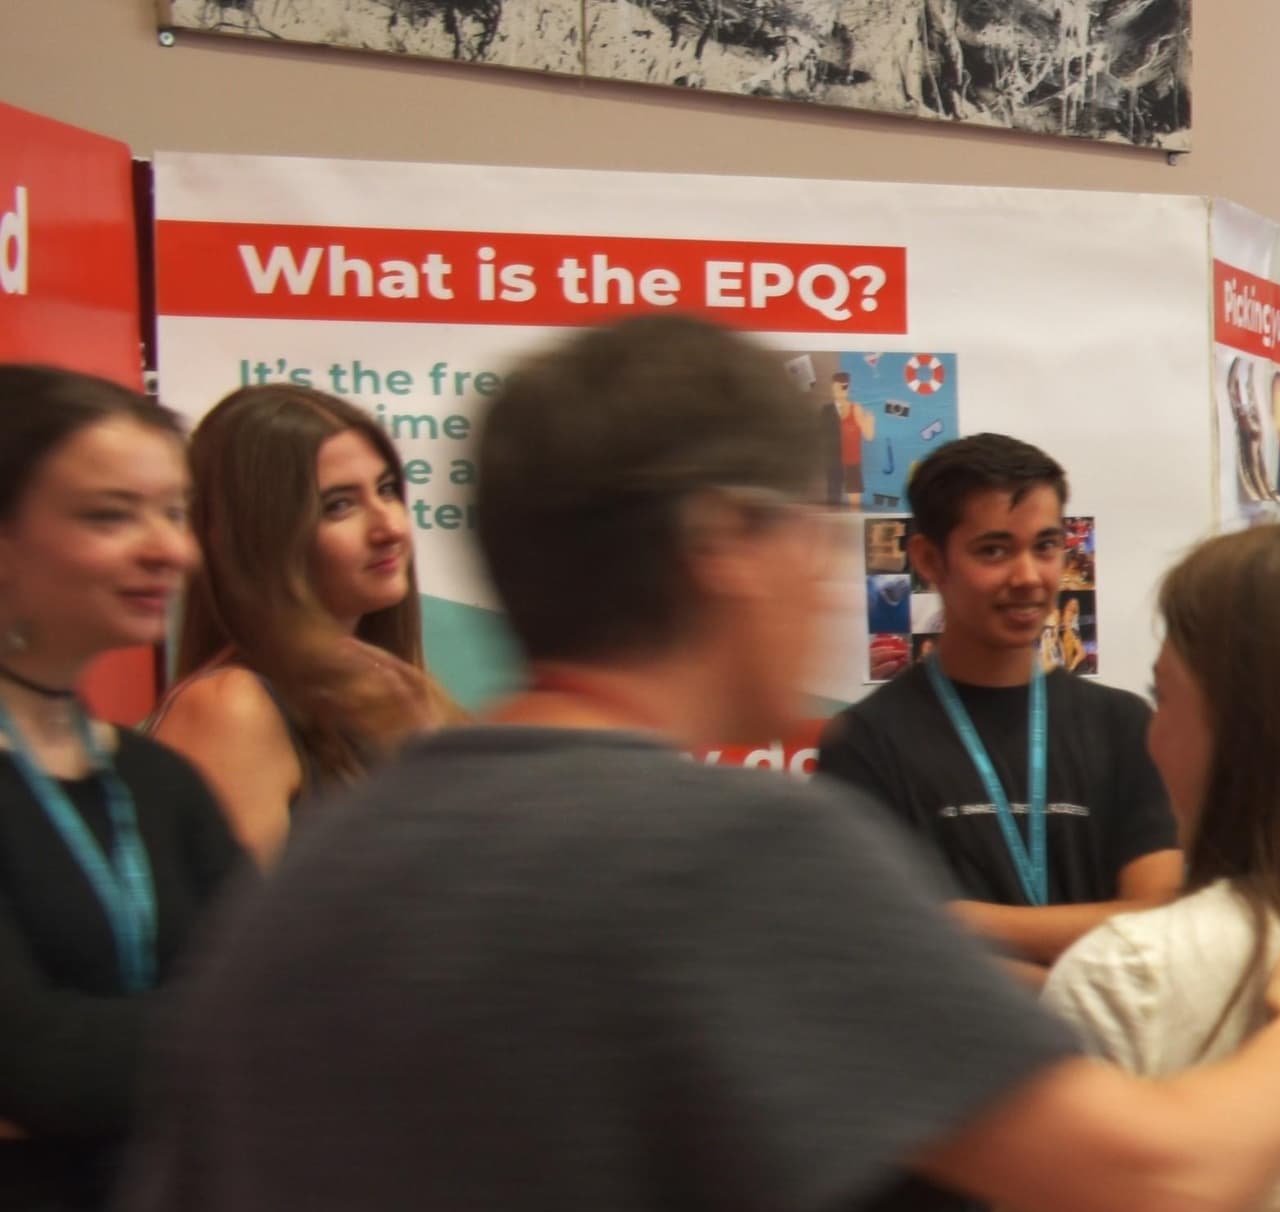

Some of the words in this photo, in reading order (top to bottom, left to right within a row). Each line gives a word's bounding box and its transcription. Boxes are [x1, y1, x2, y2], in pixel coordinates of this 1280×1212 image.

[239, 243, 455, 300] What
[477, 246, 537, 303] is
[557, 253, 682, 307] the
[704, 260, 888, 322] EPQ?
[328, 360, 414, 396] the
[428, 362, 503, 397] fre
[376, 403, 472, 440] ime
